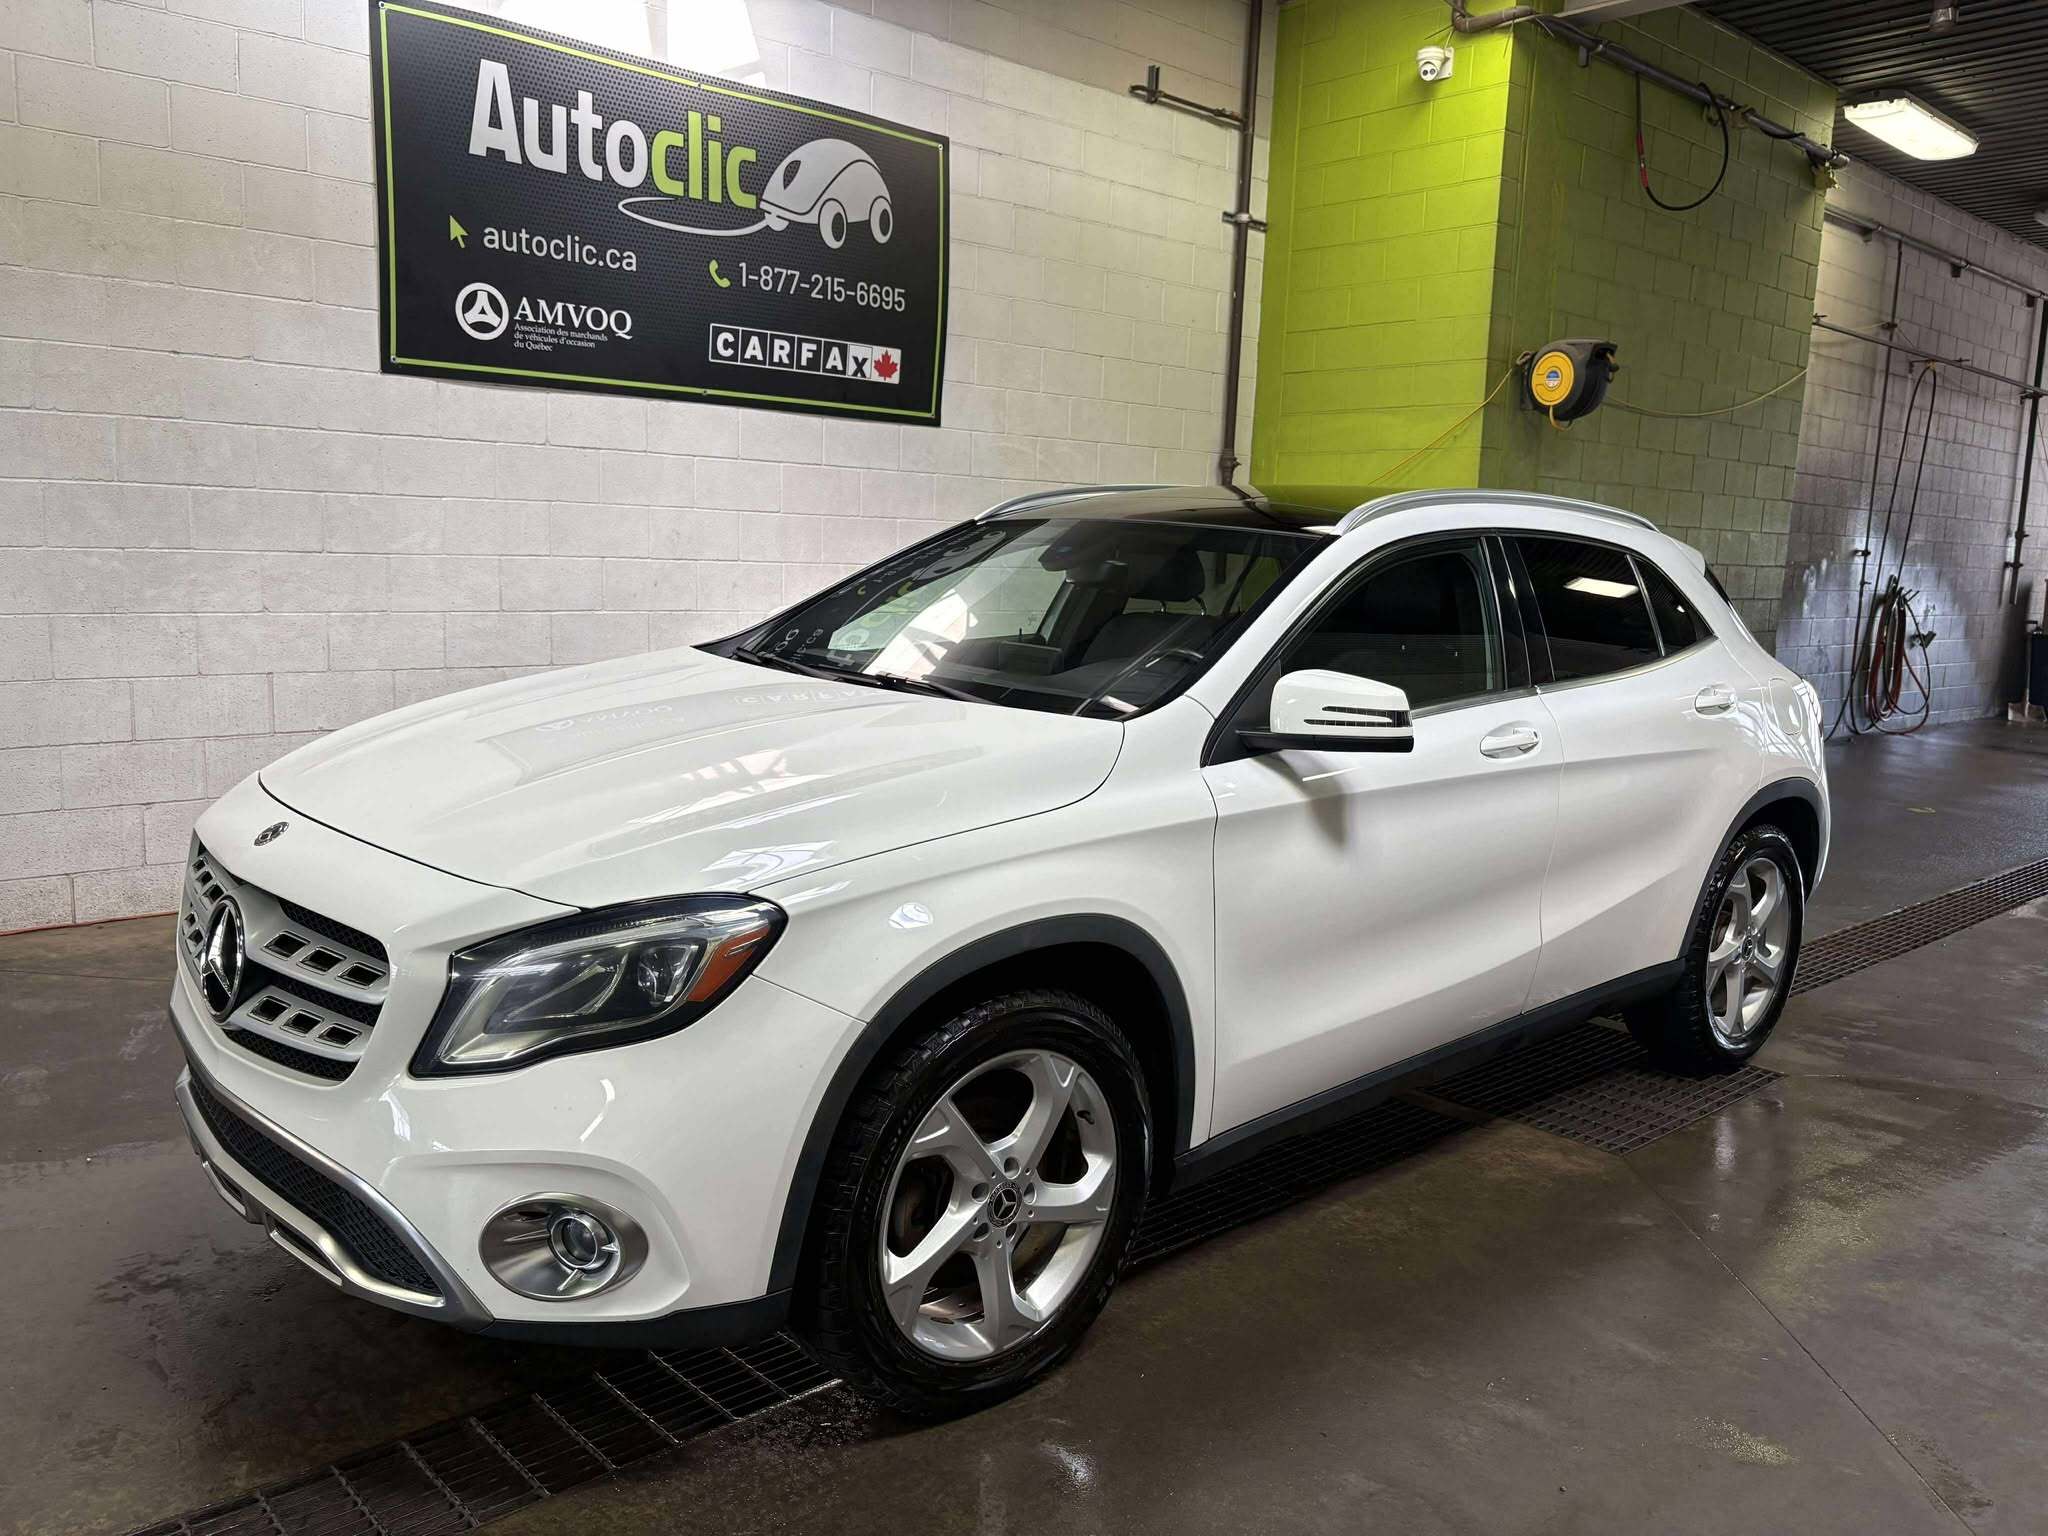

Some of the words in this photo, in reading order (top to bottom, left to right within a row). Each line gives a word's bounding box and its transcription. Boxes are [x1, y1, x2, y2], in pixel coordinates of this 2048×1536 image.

[468, 58, 758, 210] Autoclic
[483, 226, 638, 272] autoclic.ca
[738, 261, 906, 312] 1-877-215-6695
[513, 296, 633, 340] AMVOQ
[513, 330, 524, 339] de
[525, 332, 558, 344] véhicules
[514, 322, 556, 335] Association
[556, 328, 569, 337] des
[570, 331, 609, 341] marchands
[513, 339, 525, 348] du
[716, 332, 869, 379] CARFAX
